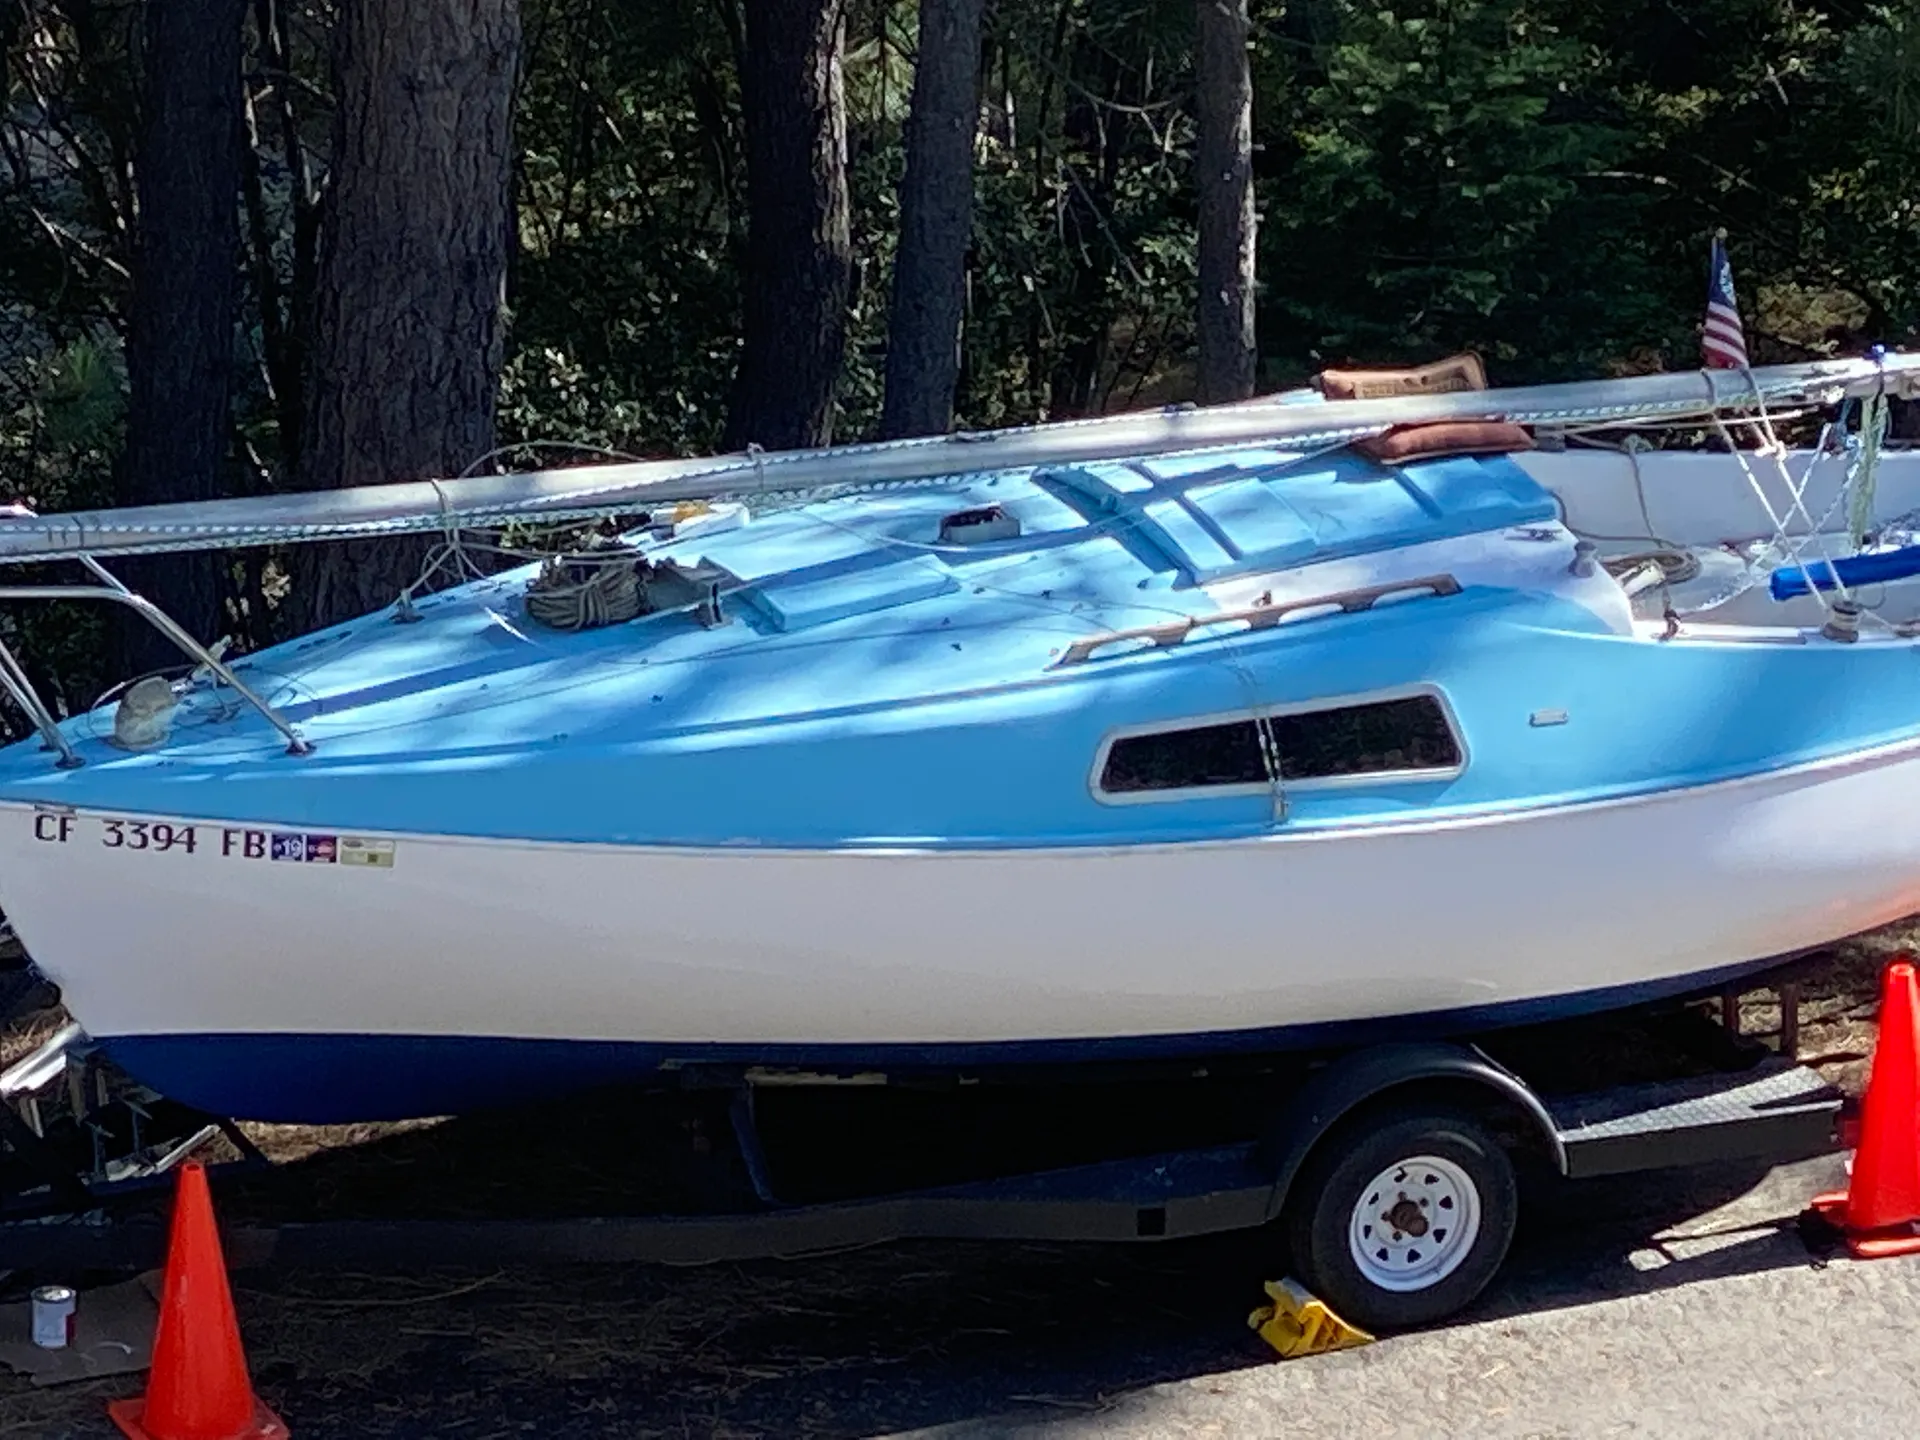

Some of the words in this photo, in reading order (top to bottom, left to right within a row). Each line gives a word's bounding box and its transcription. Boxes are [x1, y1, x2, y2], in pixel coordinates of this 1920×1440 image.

[34, 813, 78, 842] CF
[102, 819, 197, 854] 3394
[222, 828, 267, 859] FB
